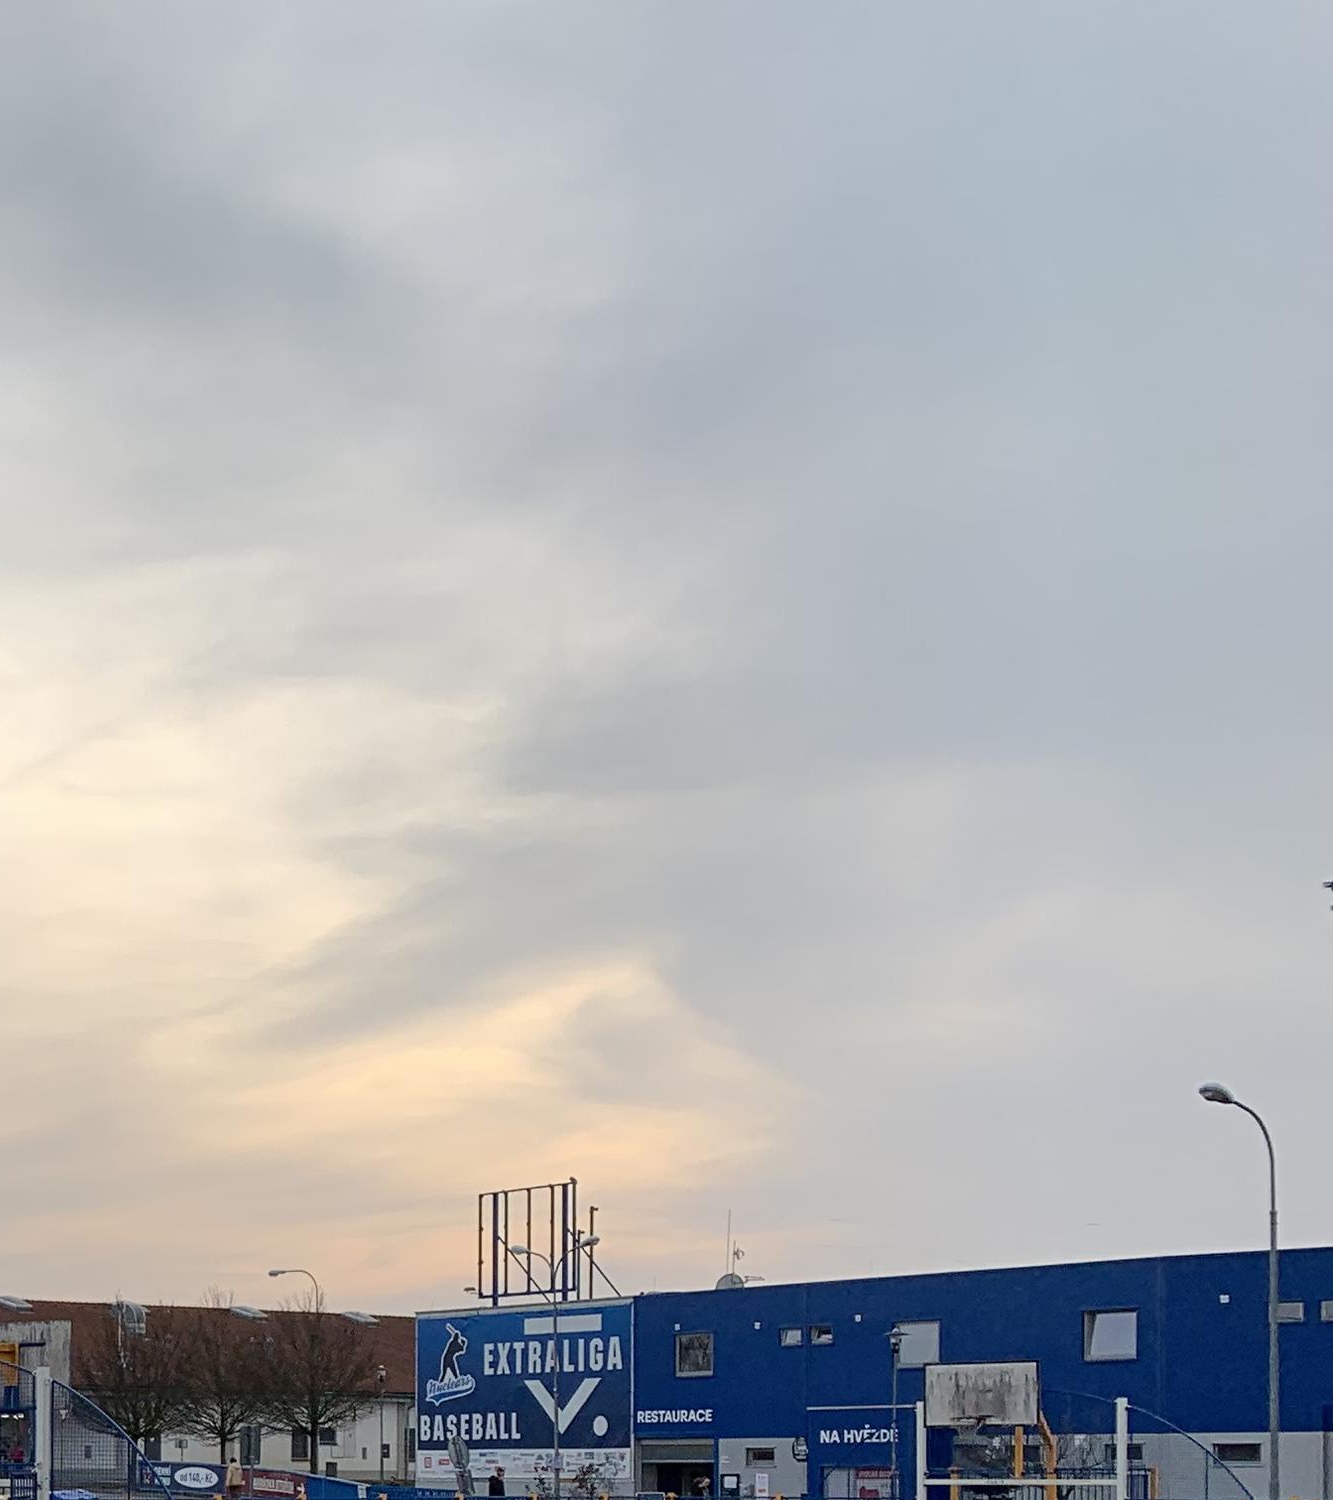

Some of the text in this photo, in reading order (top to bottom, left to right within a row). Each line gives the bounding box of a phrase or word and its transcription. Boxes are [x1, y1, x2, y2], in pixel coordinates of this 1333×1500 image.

[483, 1336, 623, 1376] EXTRALIGA
[419, 1412, 522, 1441] BASEBALL
[636, 1409, 714, 1424] RESTAURACE
[820, 1429, 840, 1444] NA
